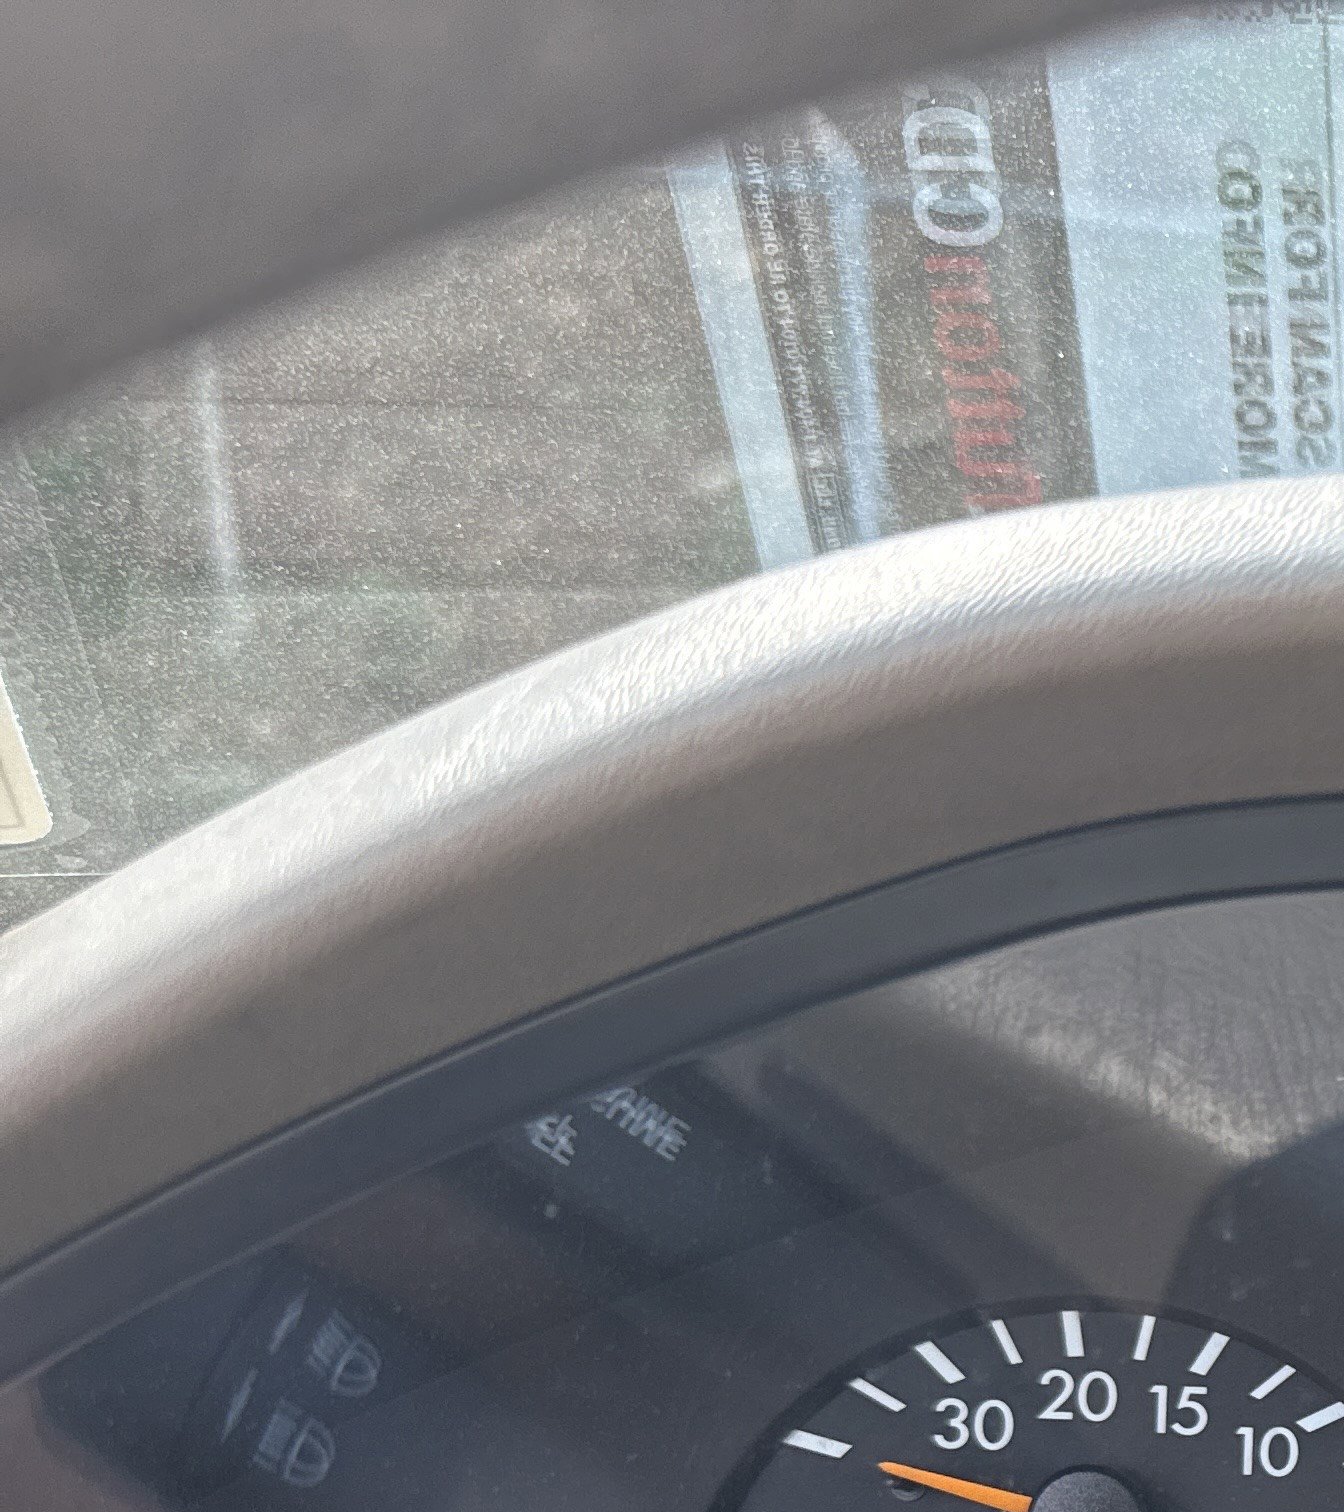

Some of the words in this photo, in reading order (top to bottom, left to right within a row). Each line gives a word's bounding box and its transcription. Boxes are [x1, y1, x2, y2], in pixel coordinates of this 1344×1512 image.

[1038, 1369, 1119, 1422] 20
[1149, 1384, 1210, 1436] 15
[933, 1397, 1015, 1451] 30
[1236, 1426, 1300, 1478] 10
